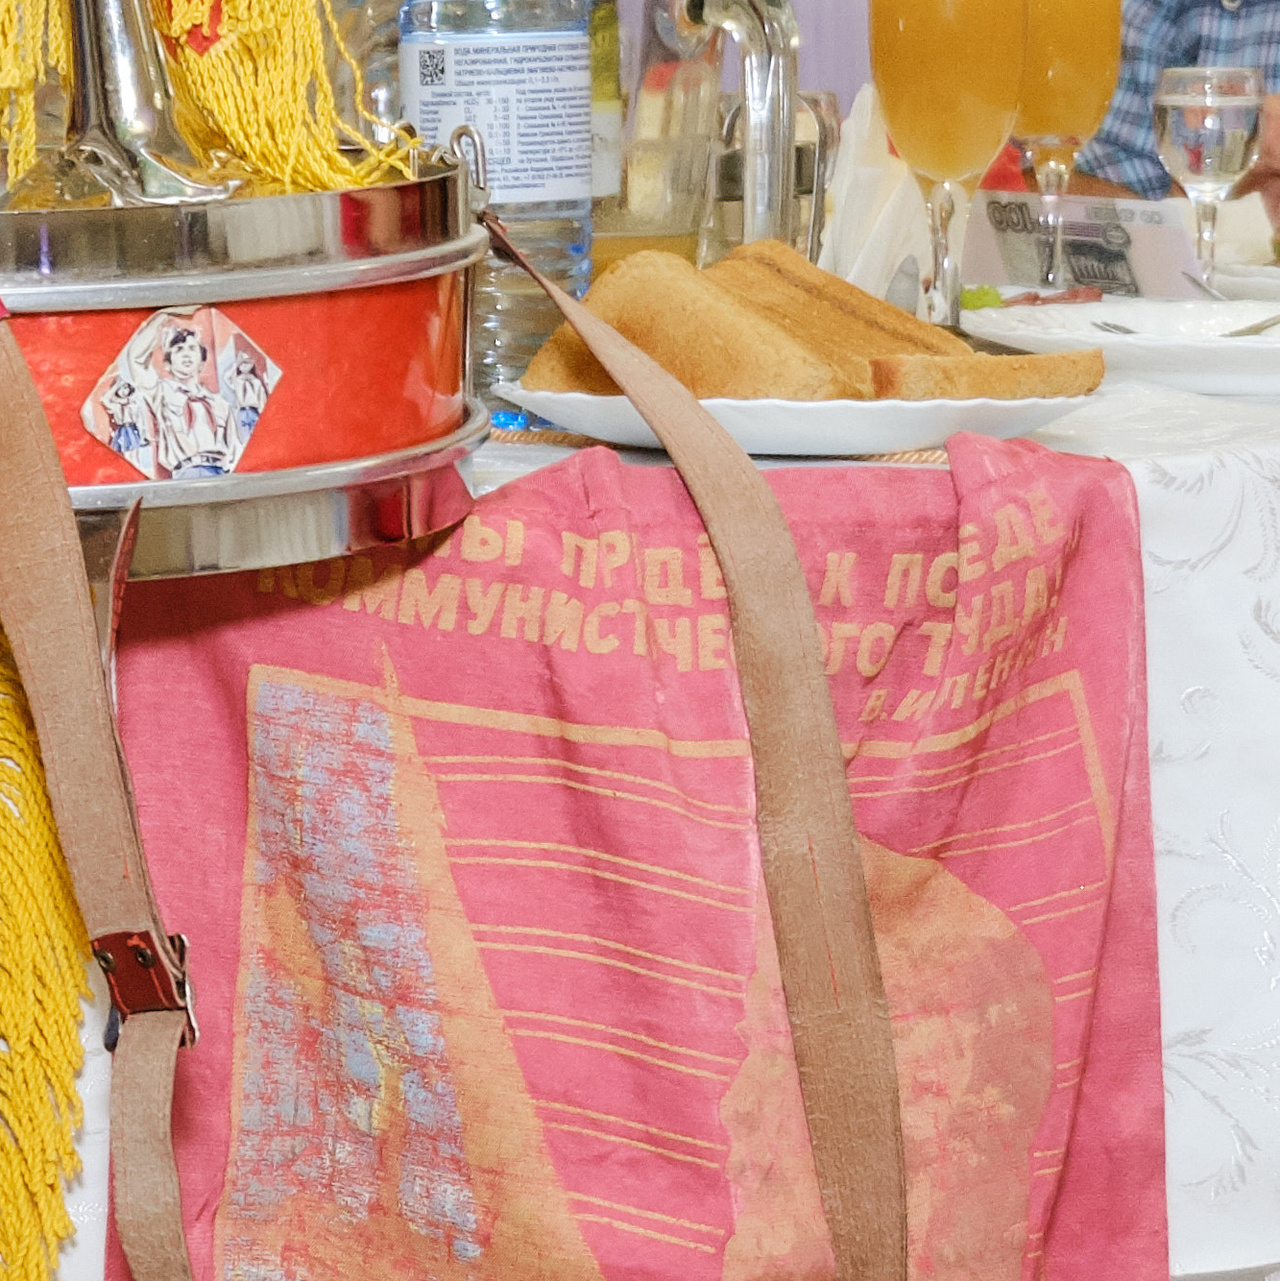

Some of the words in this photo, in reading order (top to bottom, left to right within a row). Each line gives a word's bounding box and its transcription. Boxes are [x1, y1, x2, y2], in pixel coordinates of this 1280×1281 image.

[819, 551, 857, 608] К
[883, 489, 1065, 609] ПОЕДЕ
[918, 554, 1064, 676] ТУДА!
